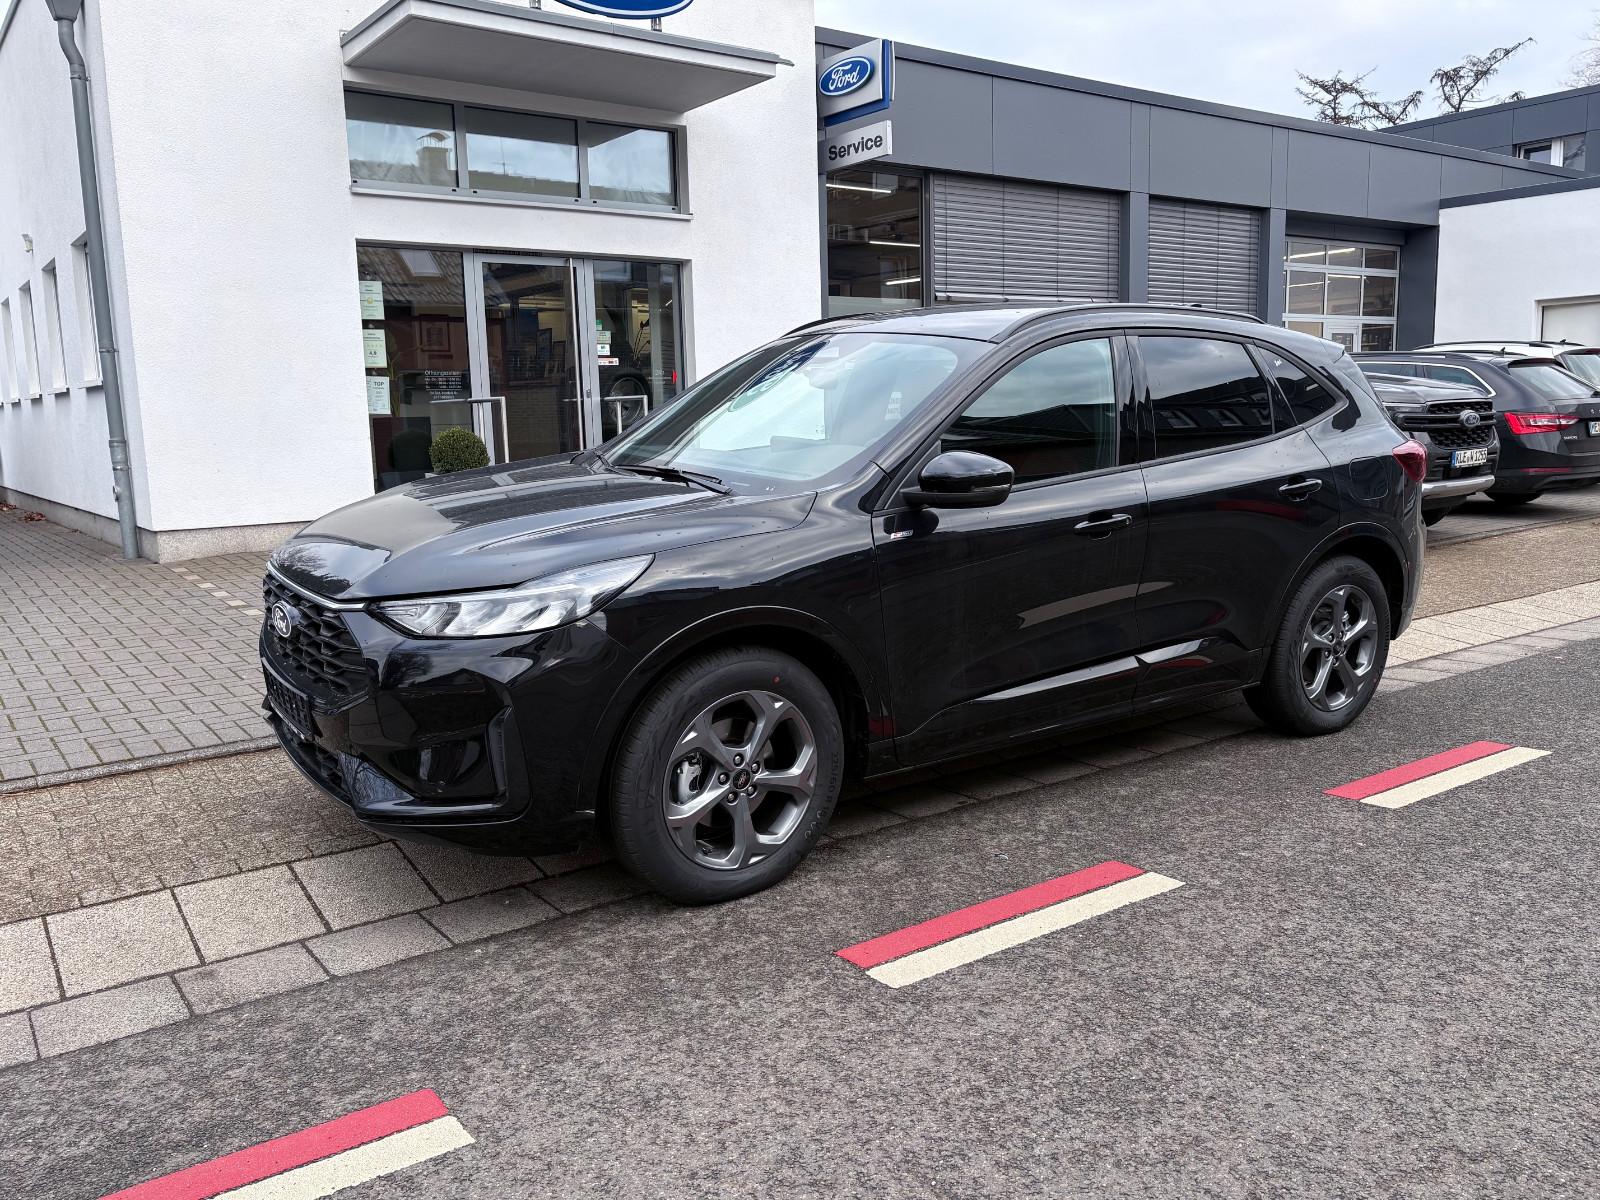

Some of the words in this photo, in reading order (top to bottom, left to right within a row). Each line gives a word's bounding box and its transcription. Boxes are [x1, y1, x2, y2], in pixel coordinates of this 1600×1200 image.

[828, 63, 860, 90] Ford
[828, 135, 883, 161] Service
[1456, 451, 1467, 464] KLE
[275, 608, 287, 633] Ford
